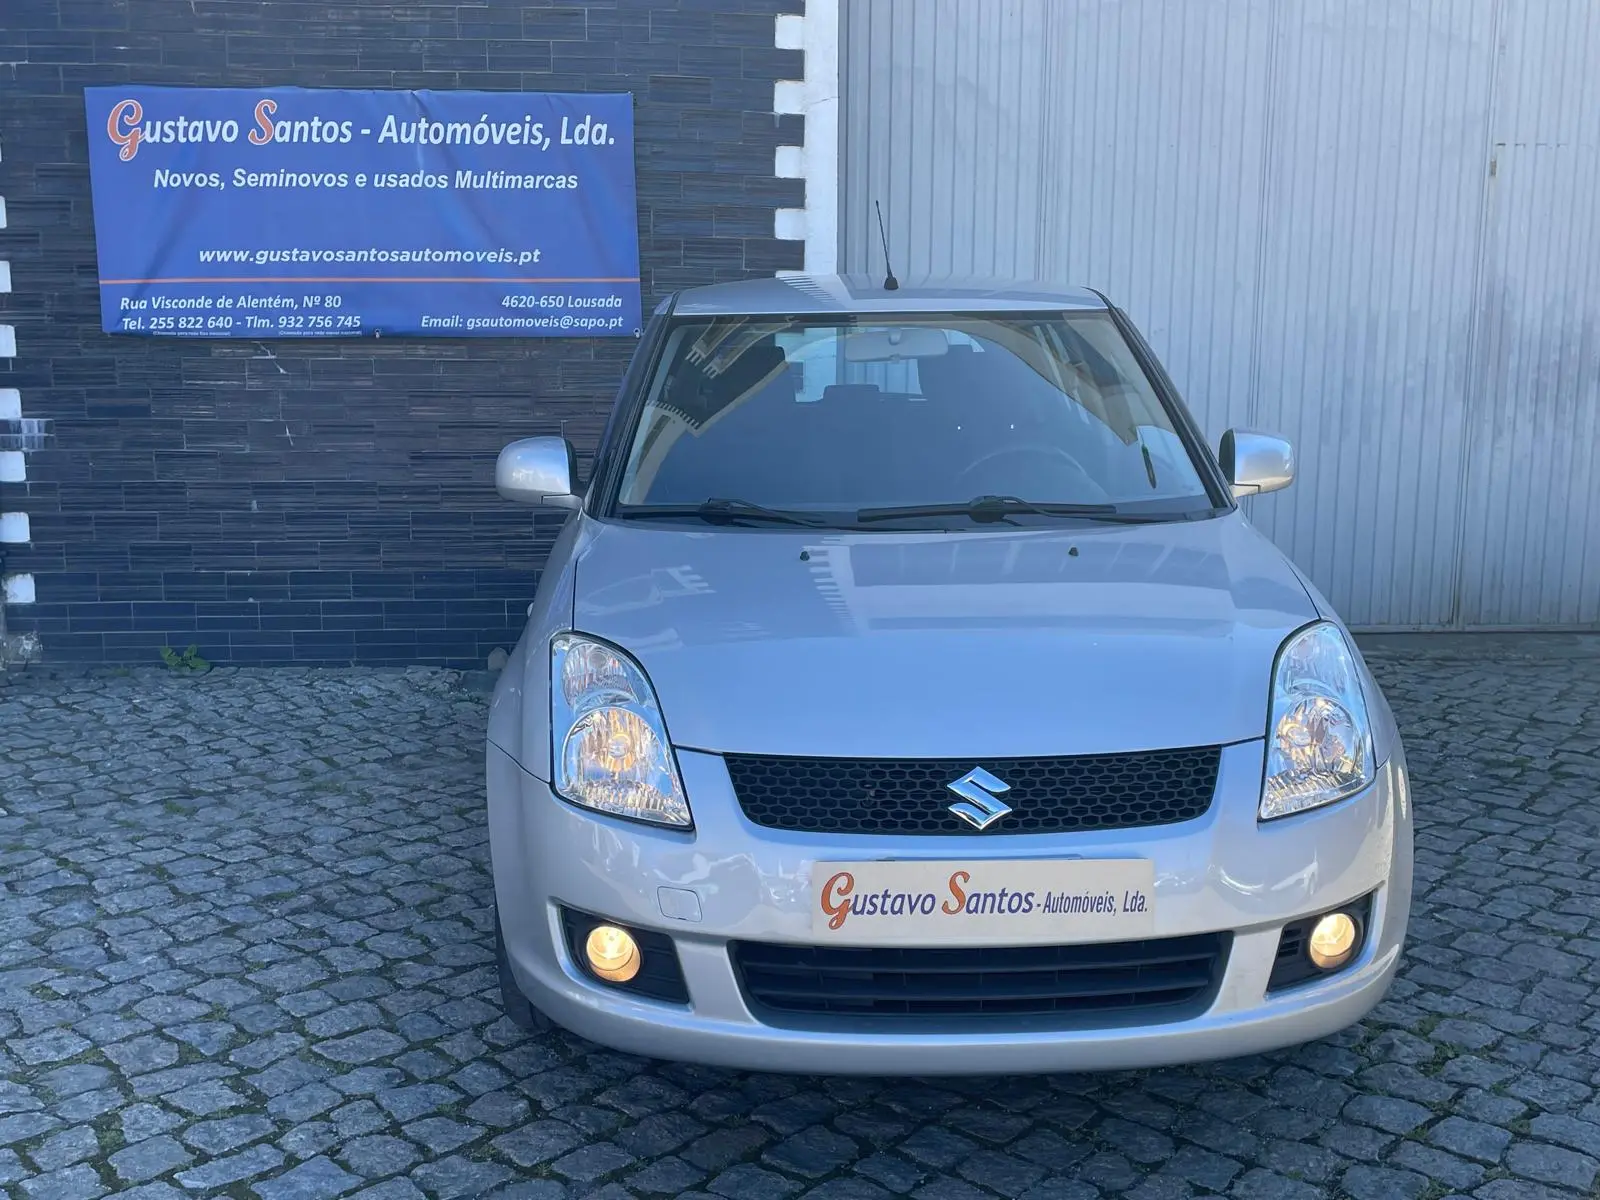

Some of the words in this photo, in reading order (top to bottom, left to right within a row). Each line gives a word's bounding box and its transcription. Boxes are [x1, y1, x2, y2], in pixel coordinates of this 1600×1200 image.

[107, 98, 239, 162] Gustavo
[248, 98, 353, 146] Santos
[360, 127, 371, 135] -
[378, 113, 551, 151] Automóveis,
[560, 115, 616, 146] Lda.
[153, 168, 226, 191] Novos,
[232, 167, 349, 188] Seminovos
[354, 174, 368, 188] e
[373, 170, 449, 189] usados
[454, 170, 579, 189] Multimarcas
[198, 247, 542, 266] www.gustavosantosautomoveis.pt
[119, 296, 149, 310] Rua
[152, 295, 213, 310] Visconde
[216, 295, 234, 309] de
[236, 294, 299, 312] Alentém,
[324, 295, 343, 309] 80
[501, 295, 565, 309] 4620-650
[567, 295, 623, 309] Lousada
[122, 317, 146, 331] Tel.
[149, 317, 175, 330] 255
[178, 316, 204, 329] 822
[207, 316, 233, 329] 640
[245, 316, 274, 329] Tlm.
[278, 315, 304, 328] 932
[308, 315, 333, 328] 756
[336, 315, 361, 328] 745
[421, 315, 464, 329] Email:
[466, 315, 624, 330] gsautomoveis@sapo.pt
[820, 871, 936, 931] Gustavo
[941, 870, 1034, 916] Santos
[1122, 890, 1148, 914] Lda.
